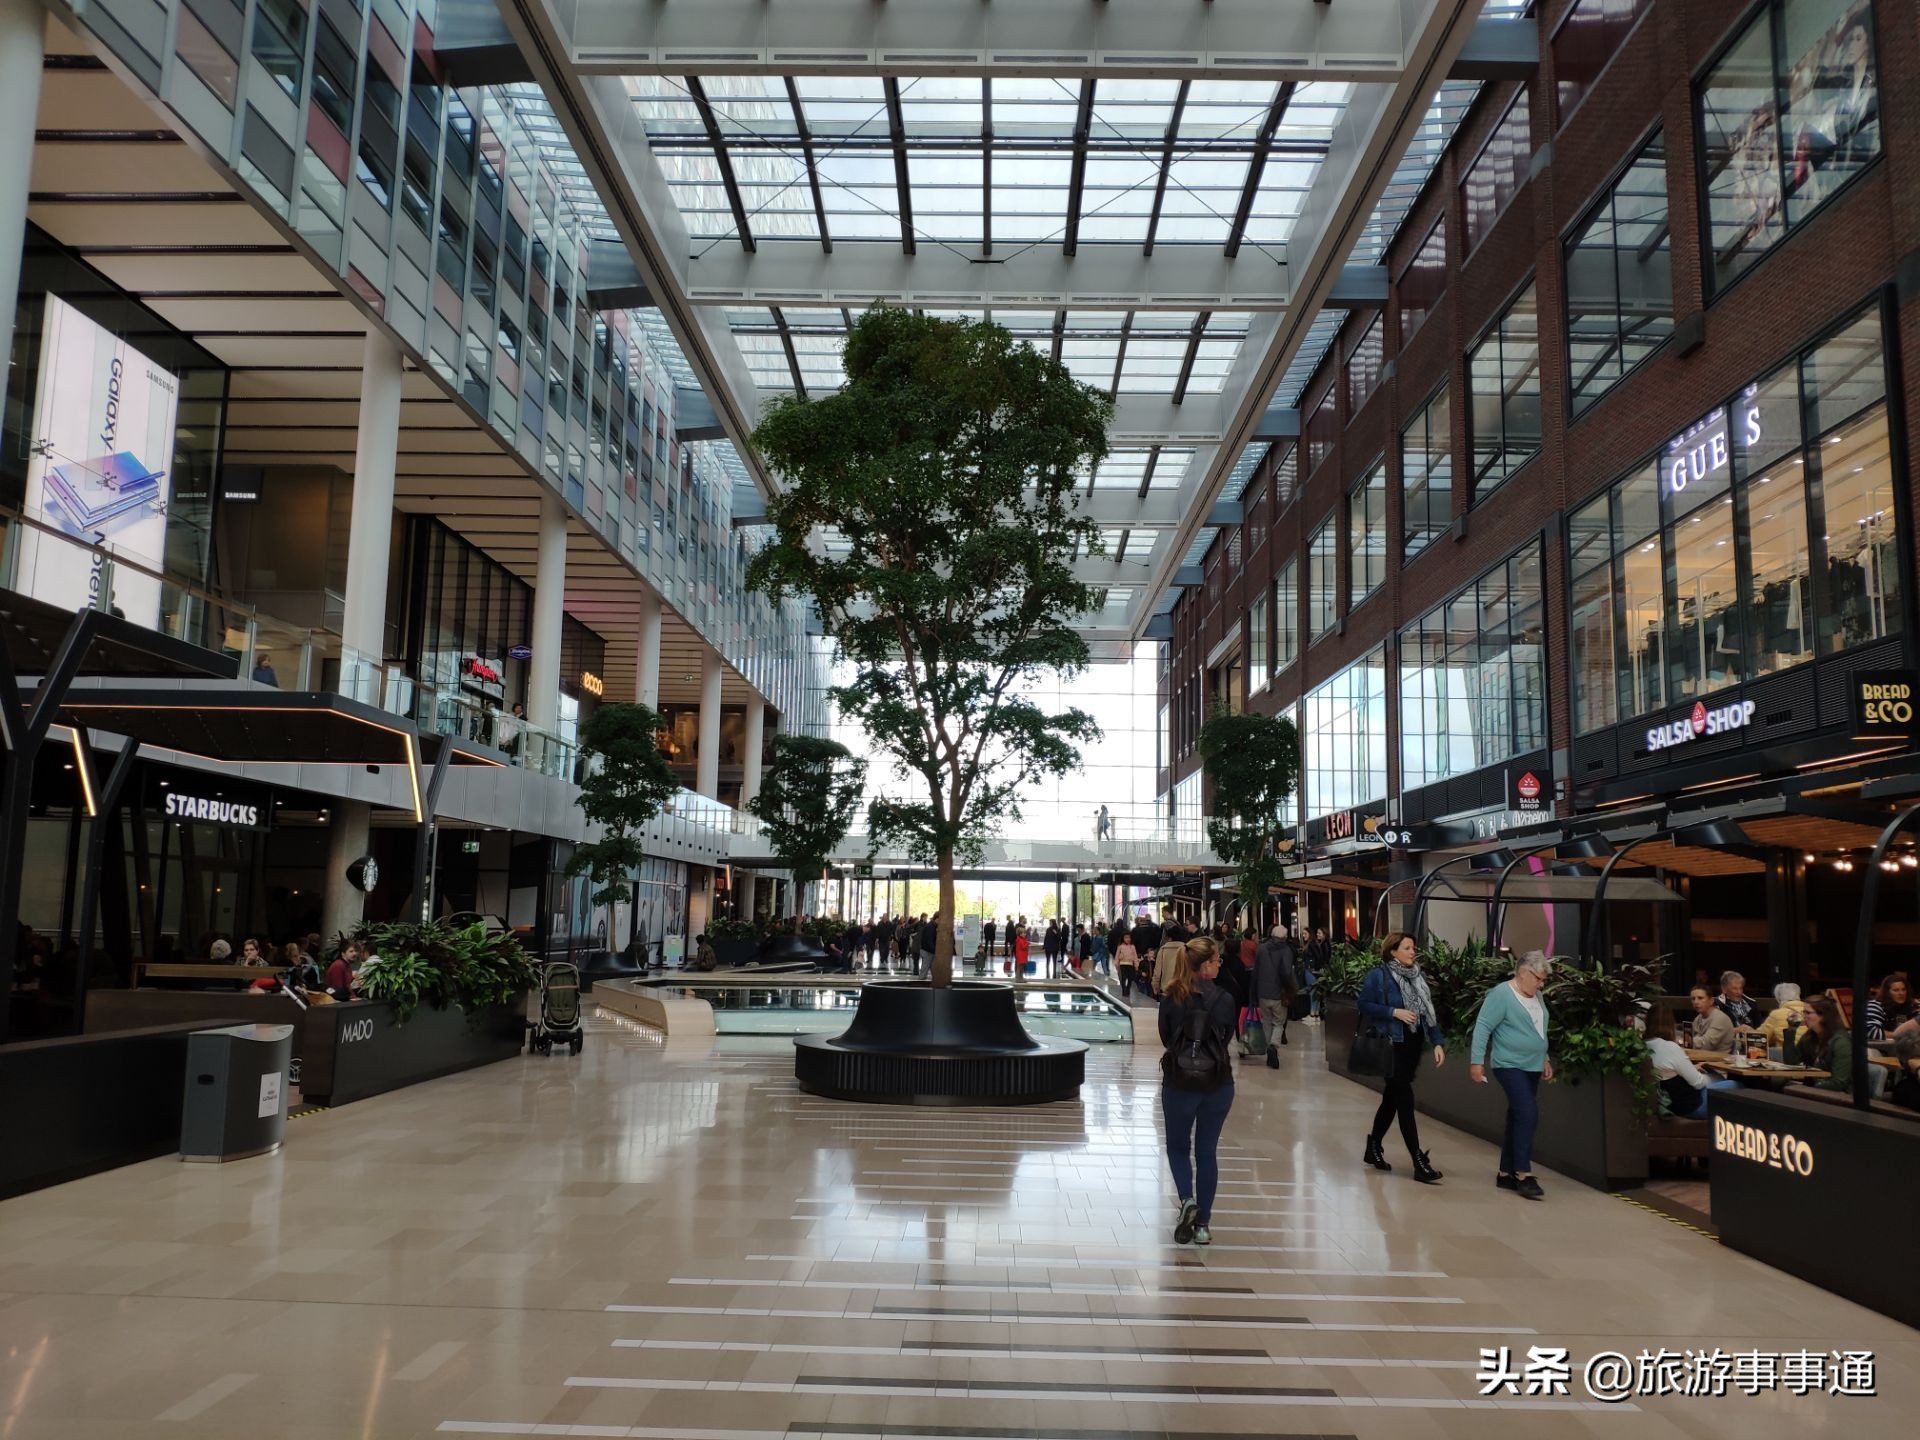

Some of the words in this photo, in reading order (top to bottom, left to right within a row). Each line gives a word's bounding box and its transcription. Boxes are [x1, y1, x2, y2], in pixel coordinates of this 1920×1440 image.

[146, 370, 174, 394] SAMSUNG
[100, 358, 122, 451] Galaxy
[1671, 405, 1761, 492] GUES
[584, 672, 603, 695] ecco
[1862, 683, 1911, 700] BREAD
[1647, 718, 1697, 752] SALSA
[1706, 700, 1756, 736] SHOP
[165, 793, 257, 826] STARBUCKS
[1326, 810, 1352, 840] LEON
[341, 1018, 374, 1044] MADO
[1714, 1115, 1768, 1163] BREAD
[1782, 1134, 1814, 1177] CO
